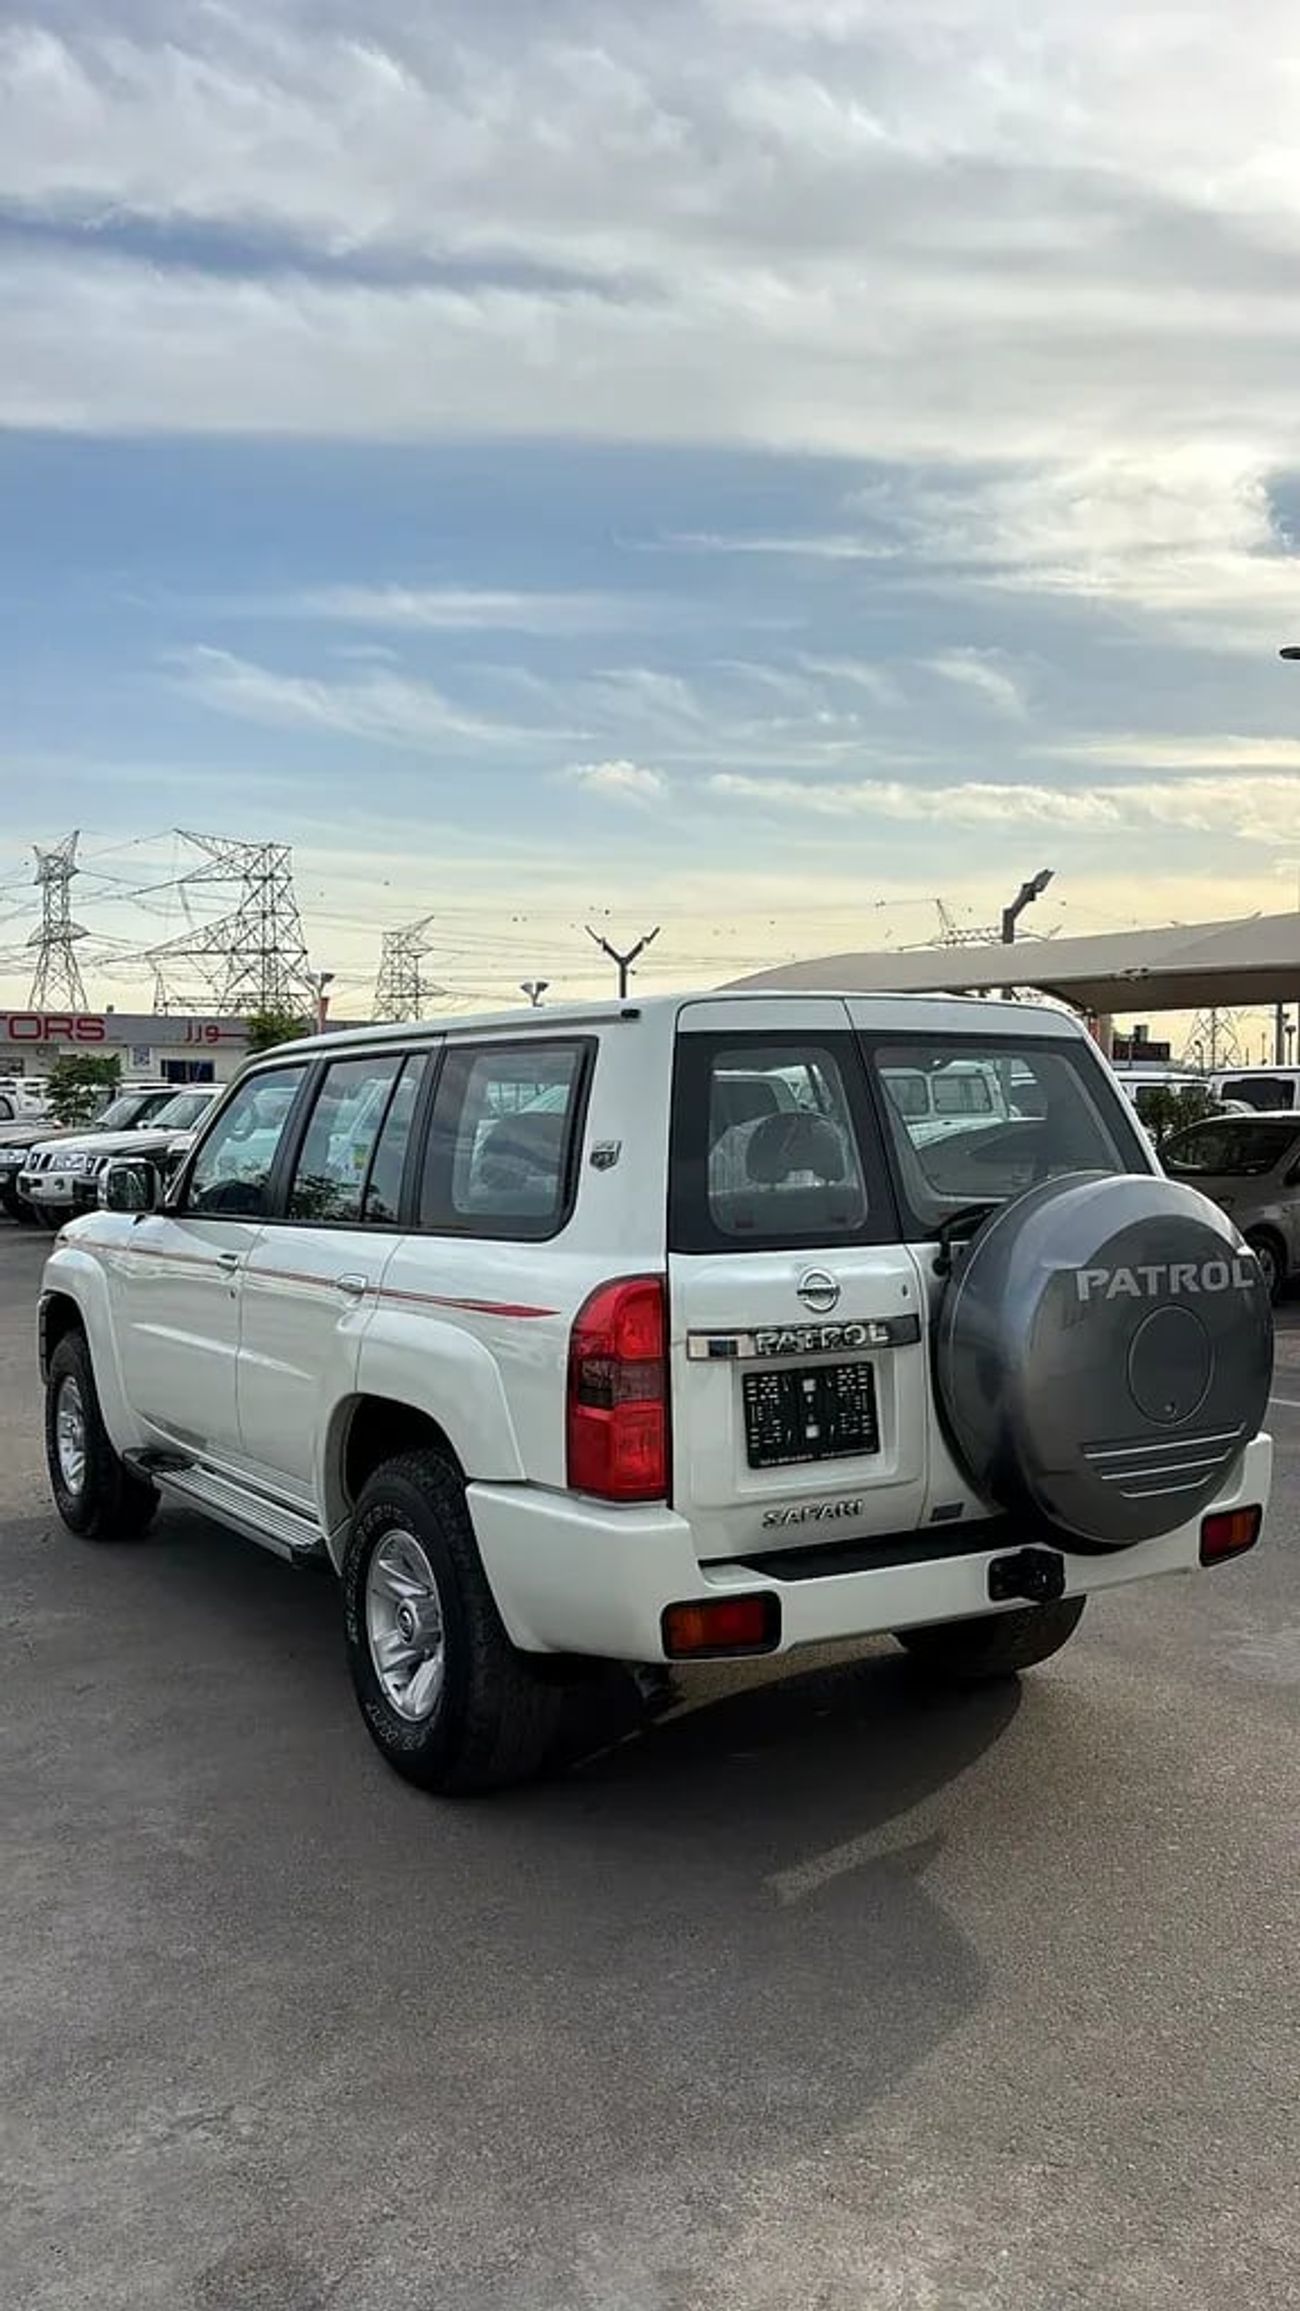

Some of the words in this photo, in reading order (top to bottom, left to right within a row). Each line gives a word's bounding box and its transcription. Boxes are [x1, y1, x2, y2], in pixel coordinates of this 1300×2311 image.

[0, 1015, 105, 1041] ORS
[1076, 1259, 1255, 1302] PATROL
[755, 1323, 889, 1355] PATROL
[762, 1499, 863, 1529] SAFARI
